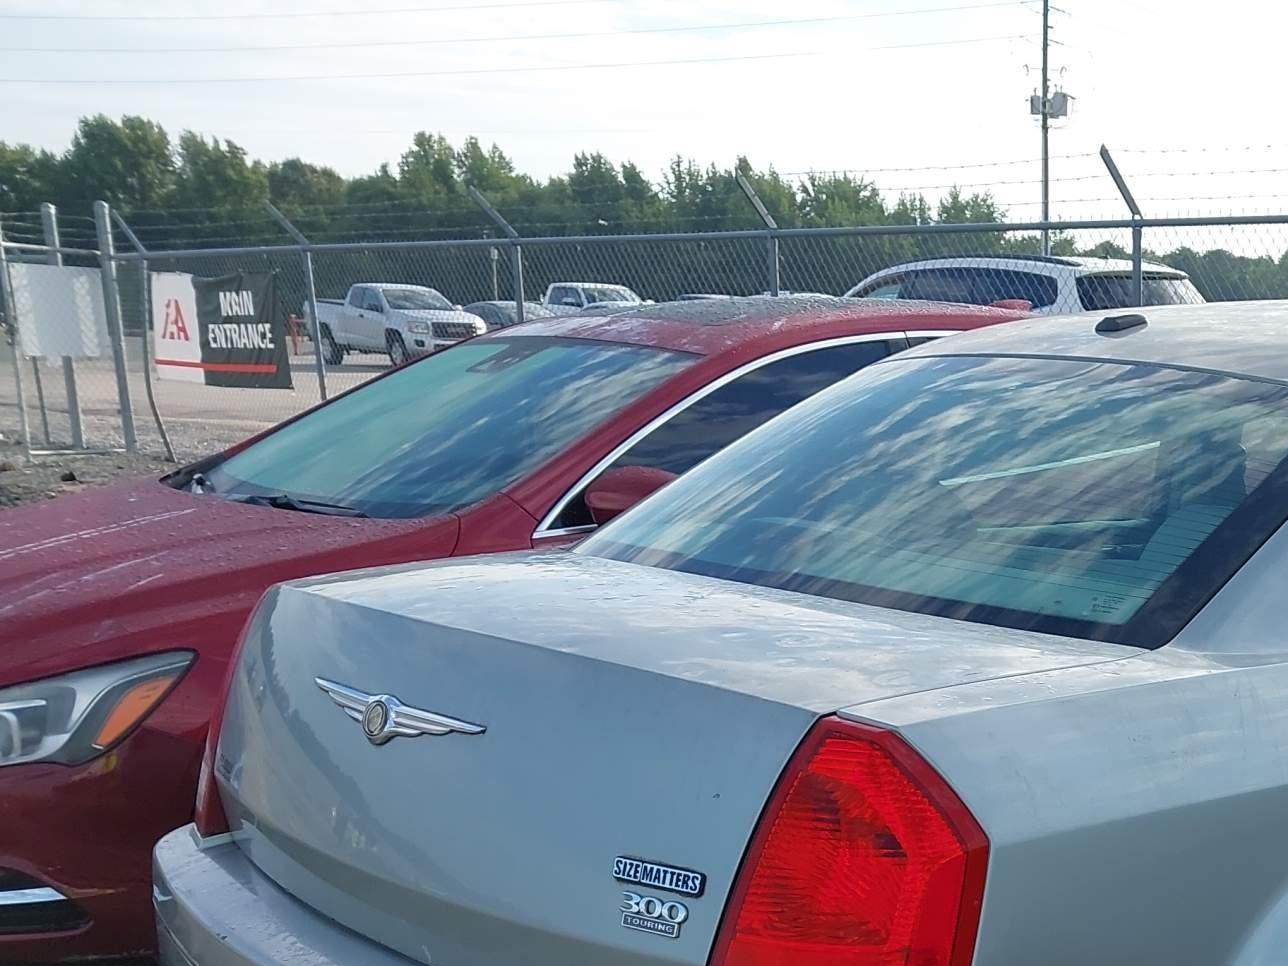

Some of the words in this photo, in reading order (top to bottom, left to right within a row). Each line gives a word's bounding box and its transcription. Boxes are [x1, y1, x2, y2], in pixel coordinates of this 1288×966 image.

[219, 290, 254, 316] MAIN
[208, 323, 275, 349] ENTRANCE
[641, 864, 700, 893] MATTERS
[620, 891, 688, 923] 300
[625, 915, 674, 933] TOURING
